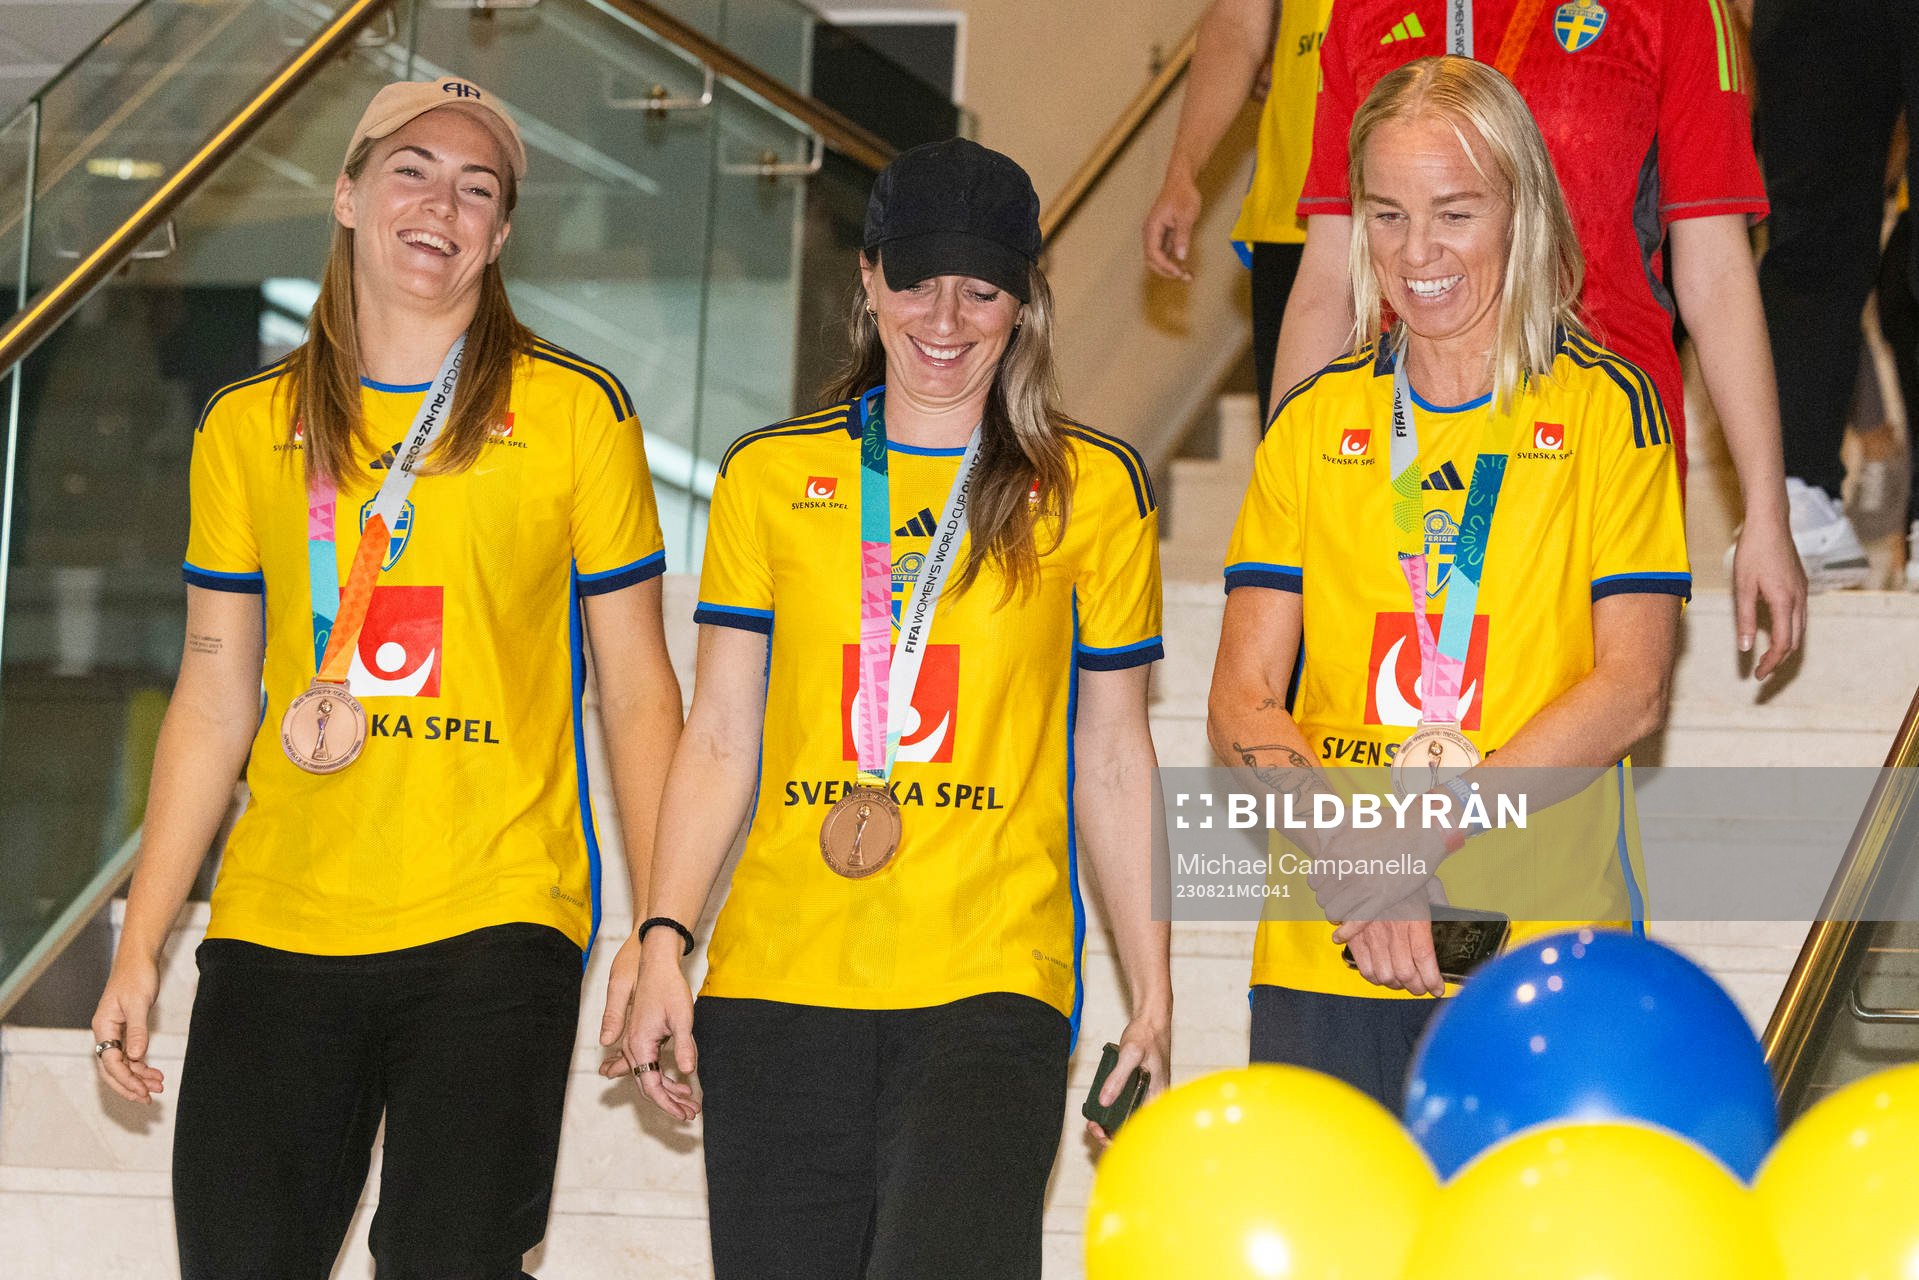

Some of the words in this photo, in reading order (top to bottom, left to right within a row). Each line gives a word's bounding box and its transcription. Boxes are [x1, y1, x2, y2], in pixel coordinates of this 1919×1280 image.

[1455, 0, 1465, 36] OMEN'S
[441, 369, 460, 395] CUP
[1396, 410, 1408, 439] FIFA
[507, 440, 528, 449] SPEL
[1517, 451, 1556, 460] SVENSKA
[1559, 449, 1574, 460] SPL
[1322, 453, 1358, 465] SVENSKA
[792, 501, 826, 510] SVENSKA
[829, 501, 849, 510] SPEL
[1424, 535, 1453, 543] VERIGE
[892, 574, 918, 582] SVERI
[905, 624, 921, 654] FIFA
[913, 564, 942, 624] WOMEN'S
[934, 520, 959, 562] WORLD
[952, 494, 967, 519] CUP
[424, 715, 500, 745] SPEL
[1322, 736, 1401, 768] SVENS
[784, 780, 924, 808] SVENKA
[935, 782, 1004, 811] SPEL
